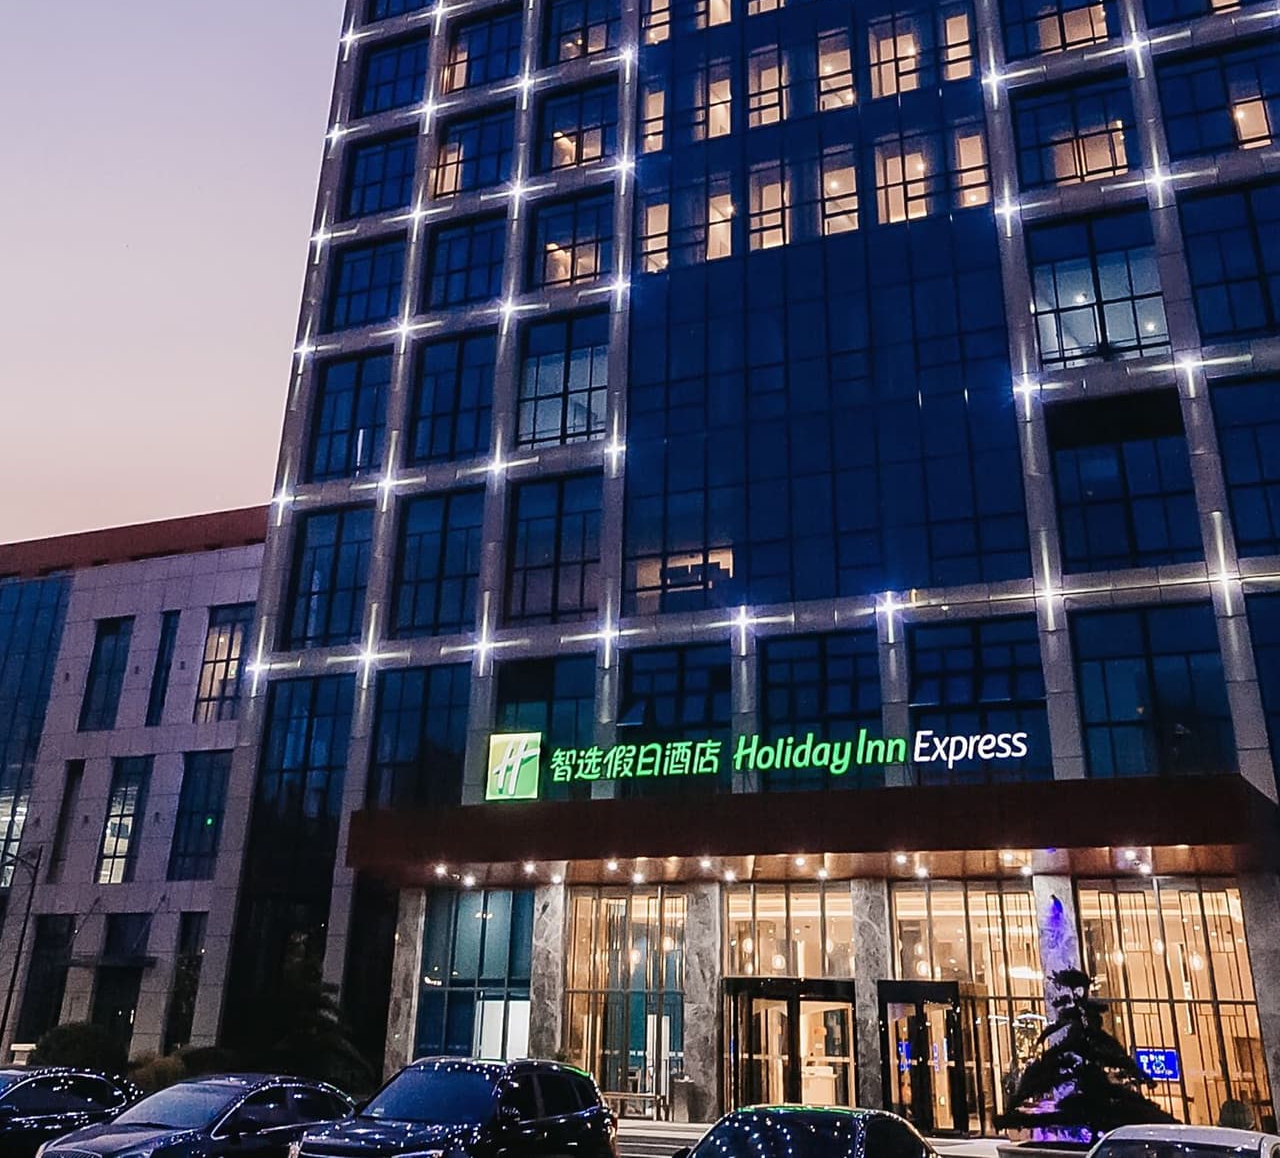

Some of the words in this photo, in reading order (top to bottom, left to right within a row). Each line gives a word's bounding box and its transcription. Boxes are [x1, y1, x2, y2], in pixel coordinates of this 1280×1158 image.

[550, 739, 722, 783] 智选假日酒店
[733, 732, 852, 775] Holiday
[856, 728, 907, 765] Inn
[913, 730, 1028, 770] Express
